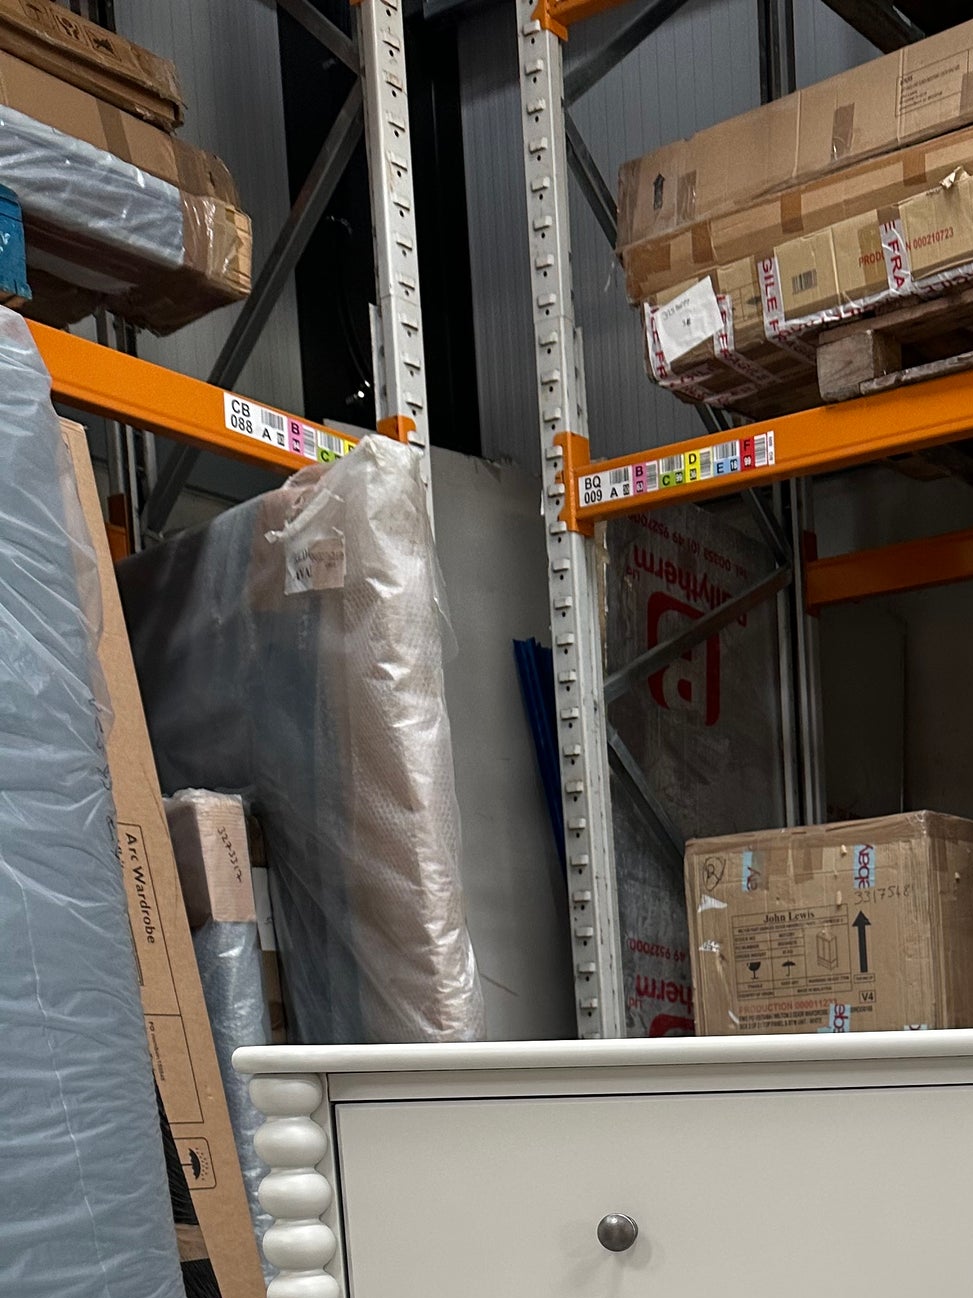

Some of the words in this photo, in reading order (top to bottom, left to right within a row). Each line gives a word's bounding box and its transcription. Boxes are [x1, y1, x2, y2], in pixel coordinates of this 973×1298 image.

[231, 399, 251, 418] CB
[230, 414, 253, 435] 088
[290, 422, 301, 436] B
[262, 428, 272, 441] A
[688, 453, 697, 465] D
[635, 465, 644, 477] B
[716, 462, 724, 474] E
[585, 475, 601, 491] BQ
[662, 474, 671, 486] C
[584, 488, 603, 504] 009
[609, 487, 619, 499] A
[123, 832, 139, 861] Arc
[131, 863, 156, 945] Wardrobe
[763, 911, 787, 925] John
[787, 909, 815, 922] Lewis
[861, 991, 874, 1002] V4
